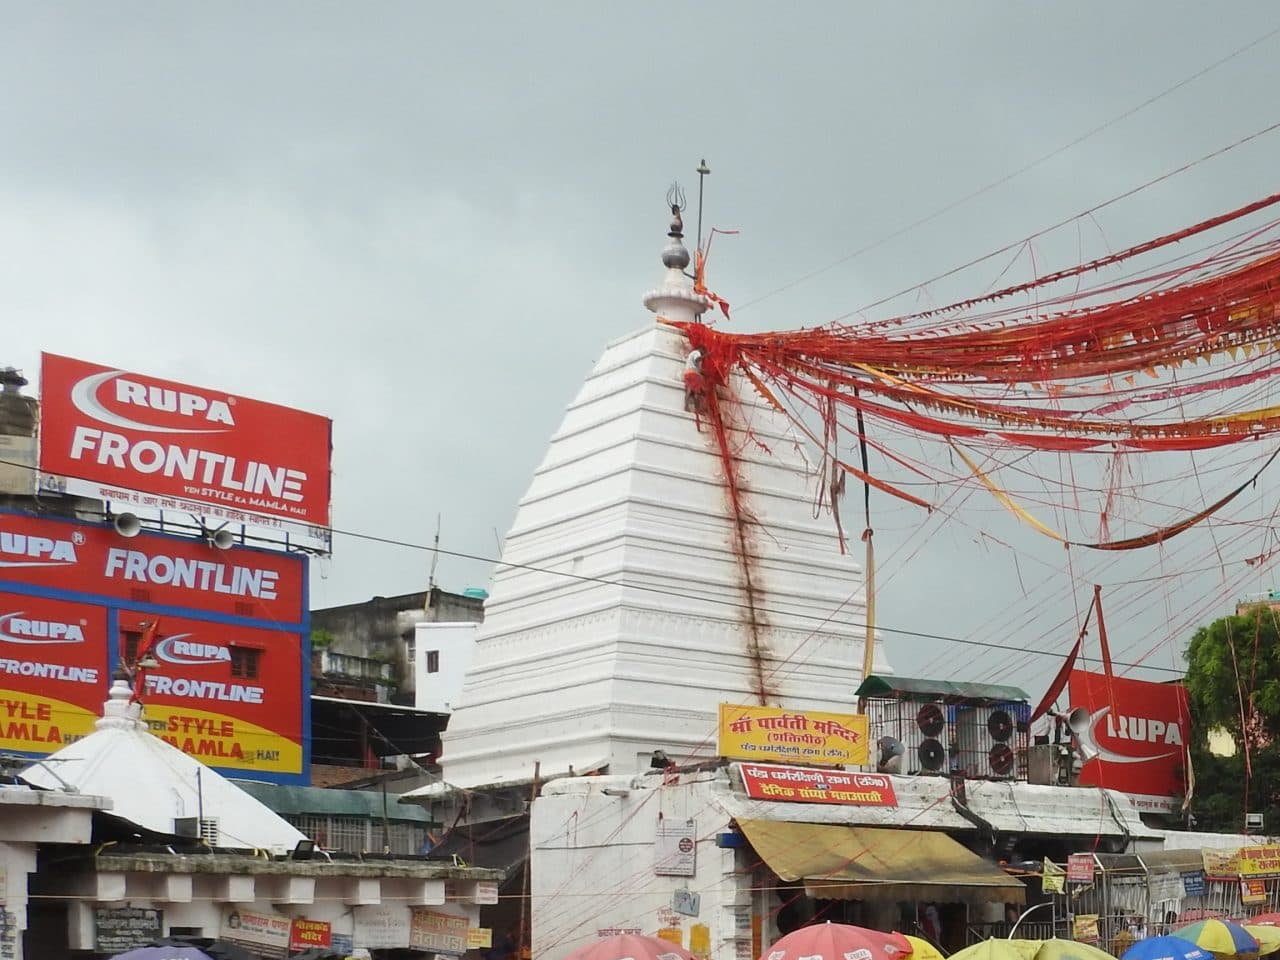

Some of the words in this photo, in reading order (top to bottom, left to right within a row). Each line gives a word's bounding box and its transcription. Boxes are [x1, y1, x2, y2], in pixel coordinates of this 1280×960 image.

[115, 379, 235, 426] RUPA
[69, 426, 308, 502] FRONTLINE
[201, 488, 234, 502] STYLE
[249, 498, 288, 512] MAMLA
[0, 531, 77, 563] UPA
[105, 547, 279, 600] FRONTLINE
[9, 617, 85, 642] RUPA
[173, 640, 232, 661] RUPA
[145, 675, 264, 704] FRONTLINE
[168, 715, 234, 738] STYLE
[757, 714, 809, 730] पार्वती
[813, 719, 862, 743] मन्दिर
[1107, 713, 1184, 746] RUPA
